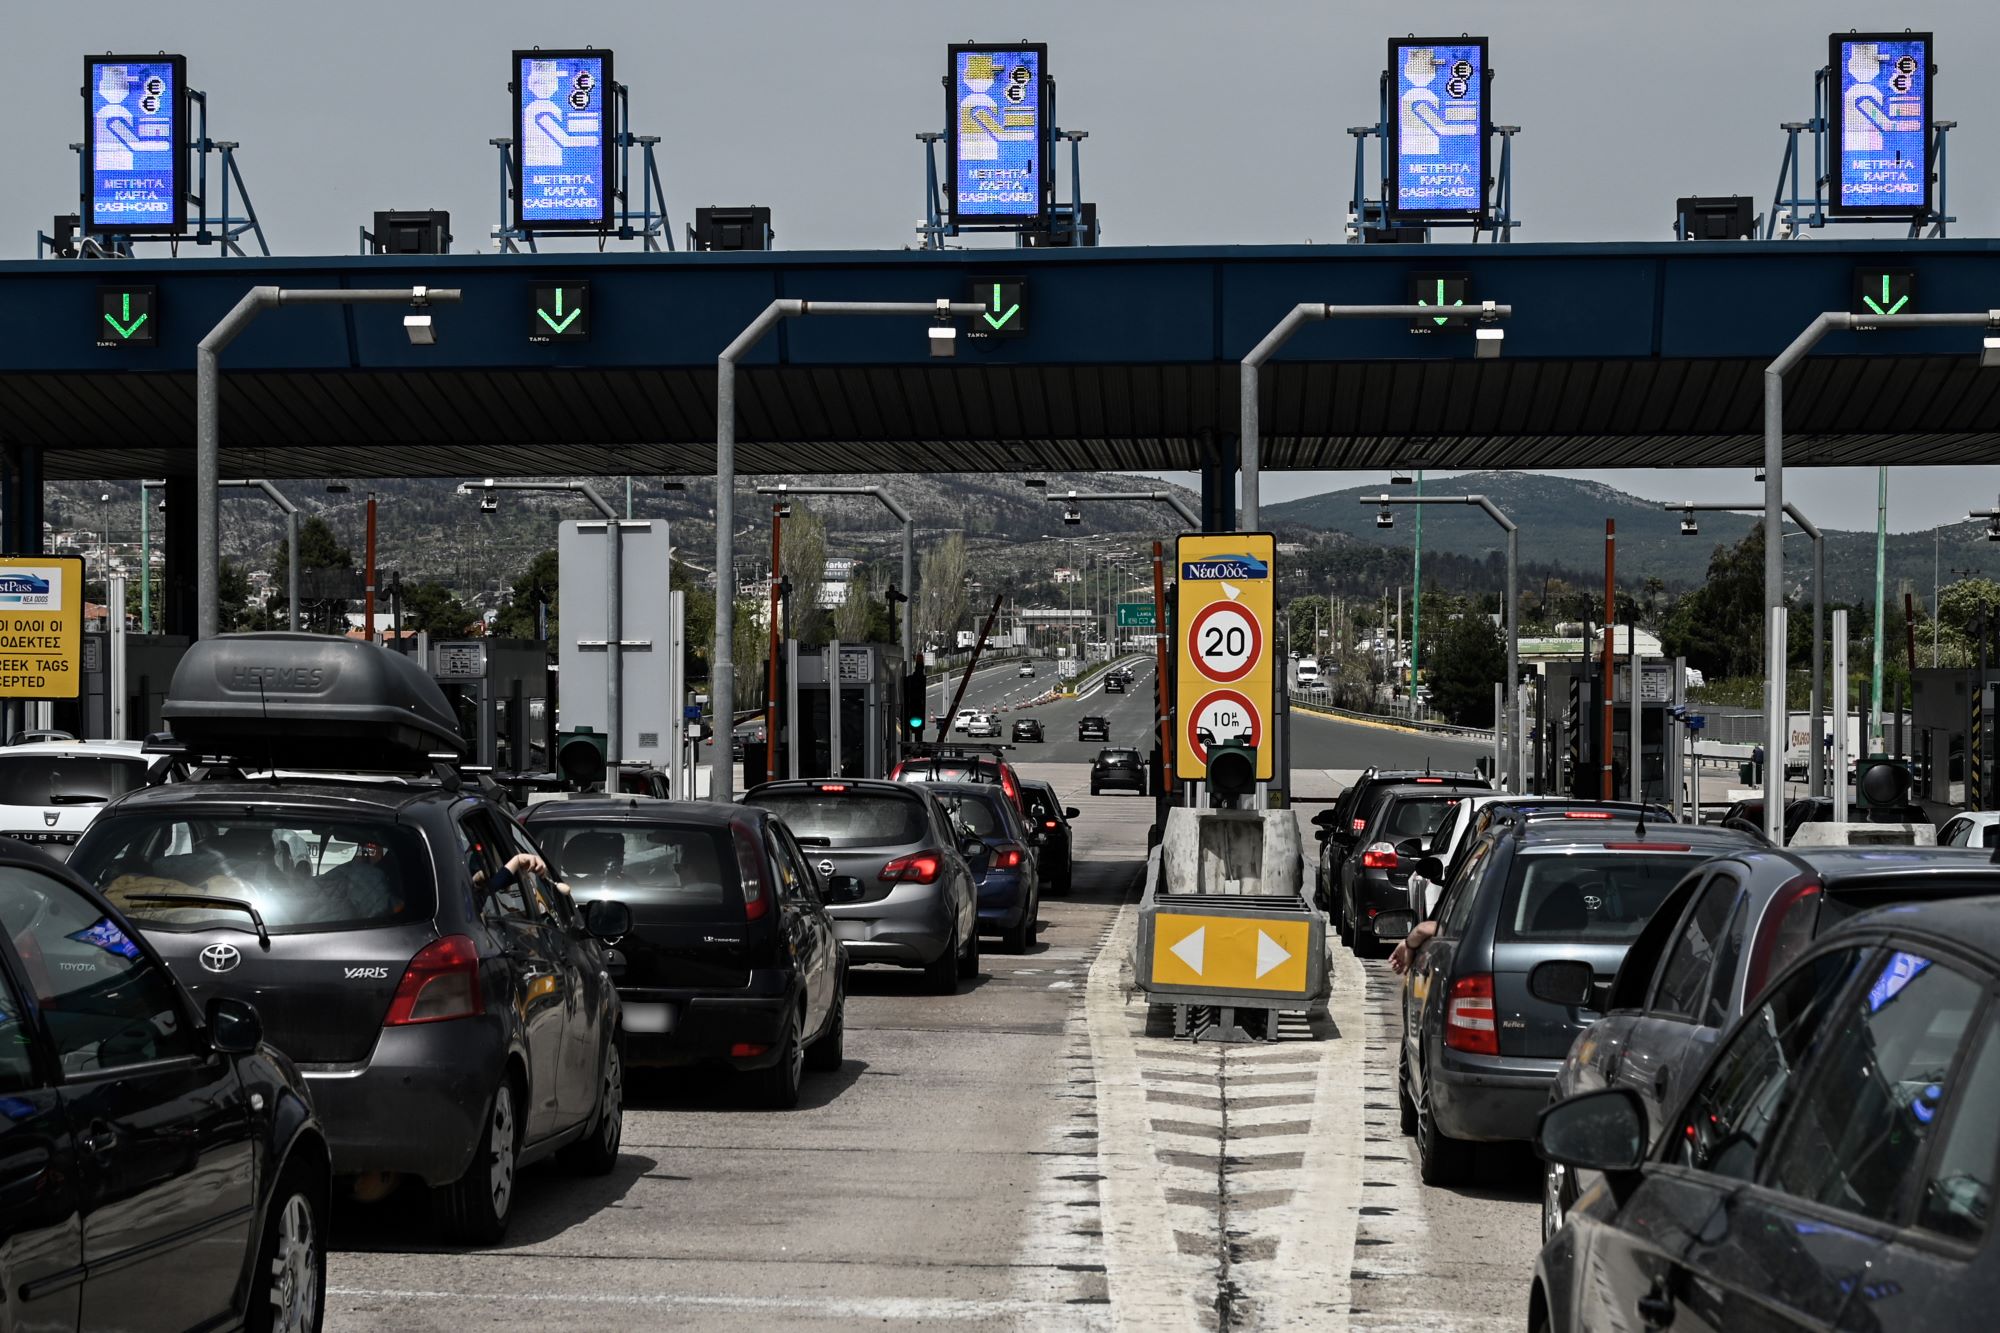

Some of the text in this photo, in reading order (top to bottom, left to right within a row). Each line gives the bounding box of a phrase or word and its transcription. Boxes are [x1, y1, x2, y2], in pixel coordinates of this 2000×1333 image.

[14, 620, 44, 632] ΟΛΟΙ
[50, 621, 62, 632] ΟΙ
[1205, 627, 1245, 657] 20
[36, 660, 69, 672] TAGS
[232, 666, 323, 688] HERMES
[59, 963, 96, 971] TOYOTA
